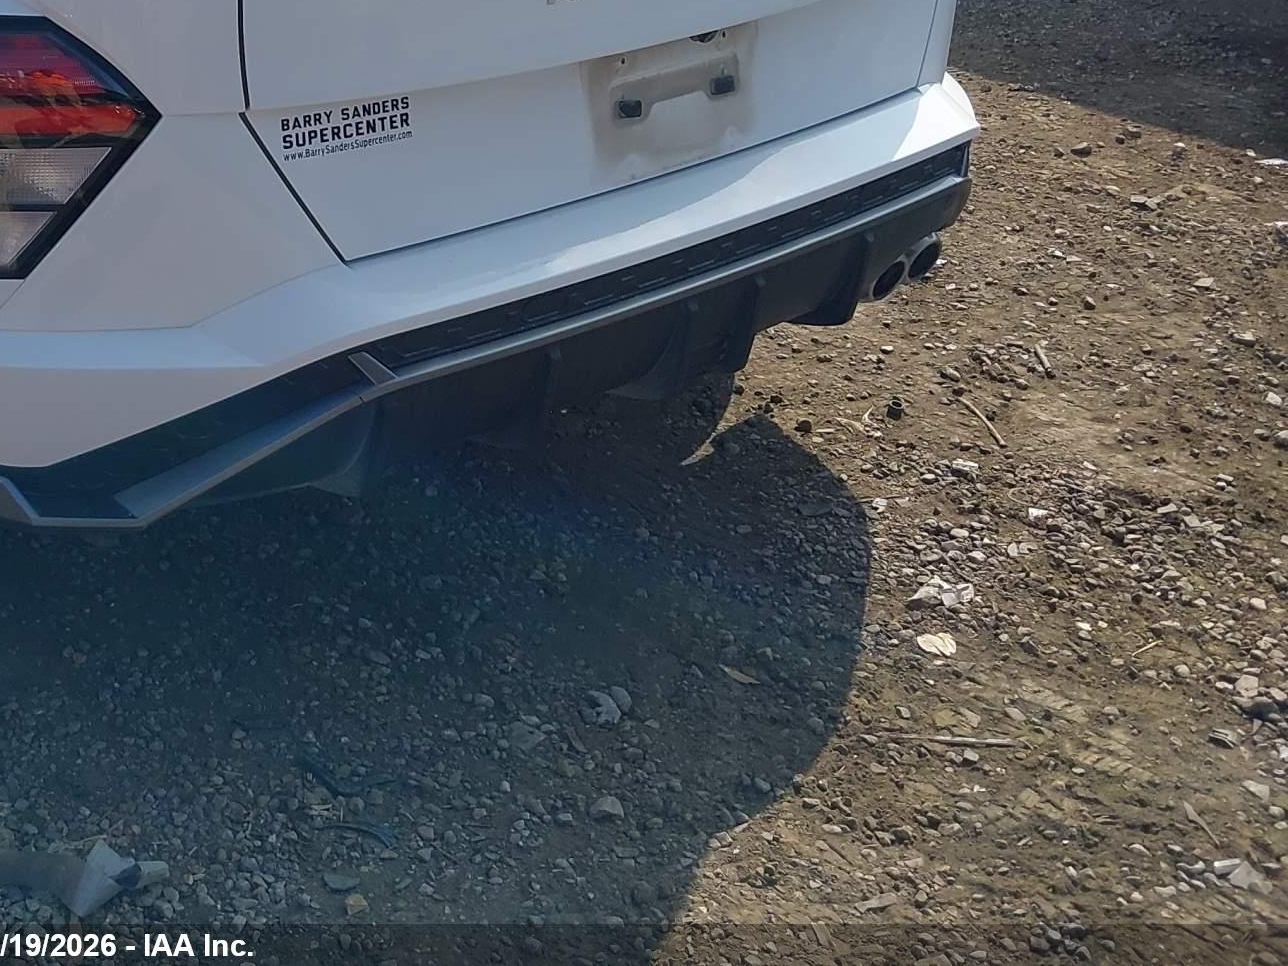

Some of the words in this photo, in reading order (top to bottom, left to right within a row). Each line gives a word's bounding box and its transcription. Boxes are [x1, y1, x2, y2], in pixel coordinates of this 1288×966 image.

[281, 110, 333, 132] BARRY
[340, 96, 410, 121] SANDERS
[282, 112, 410, 150] SUPERCENTER
[283, 130, 413, 162] www.BarrySandersSupercenter.com
